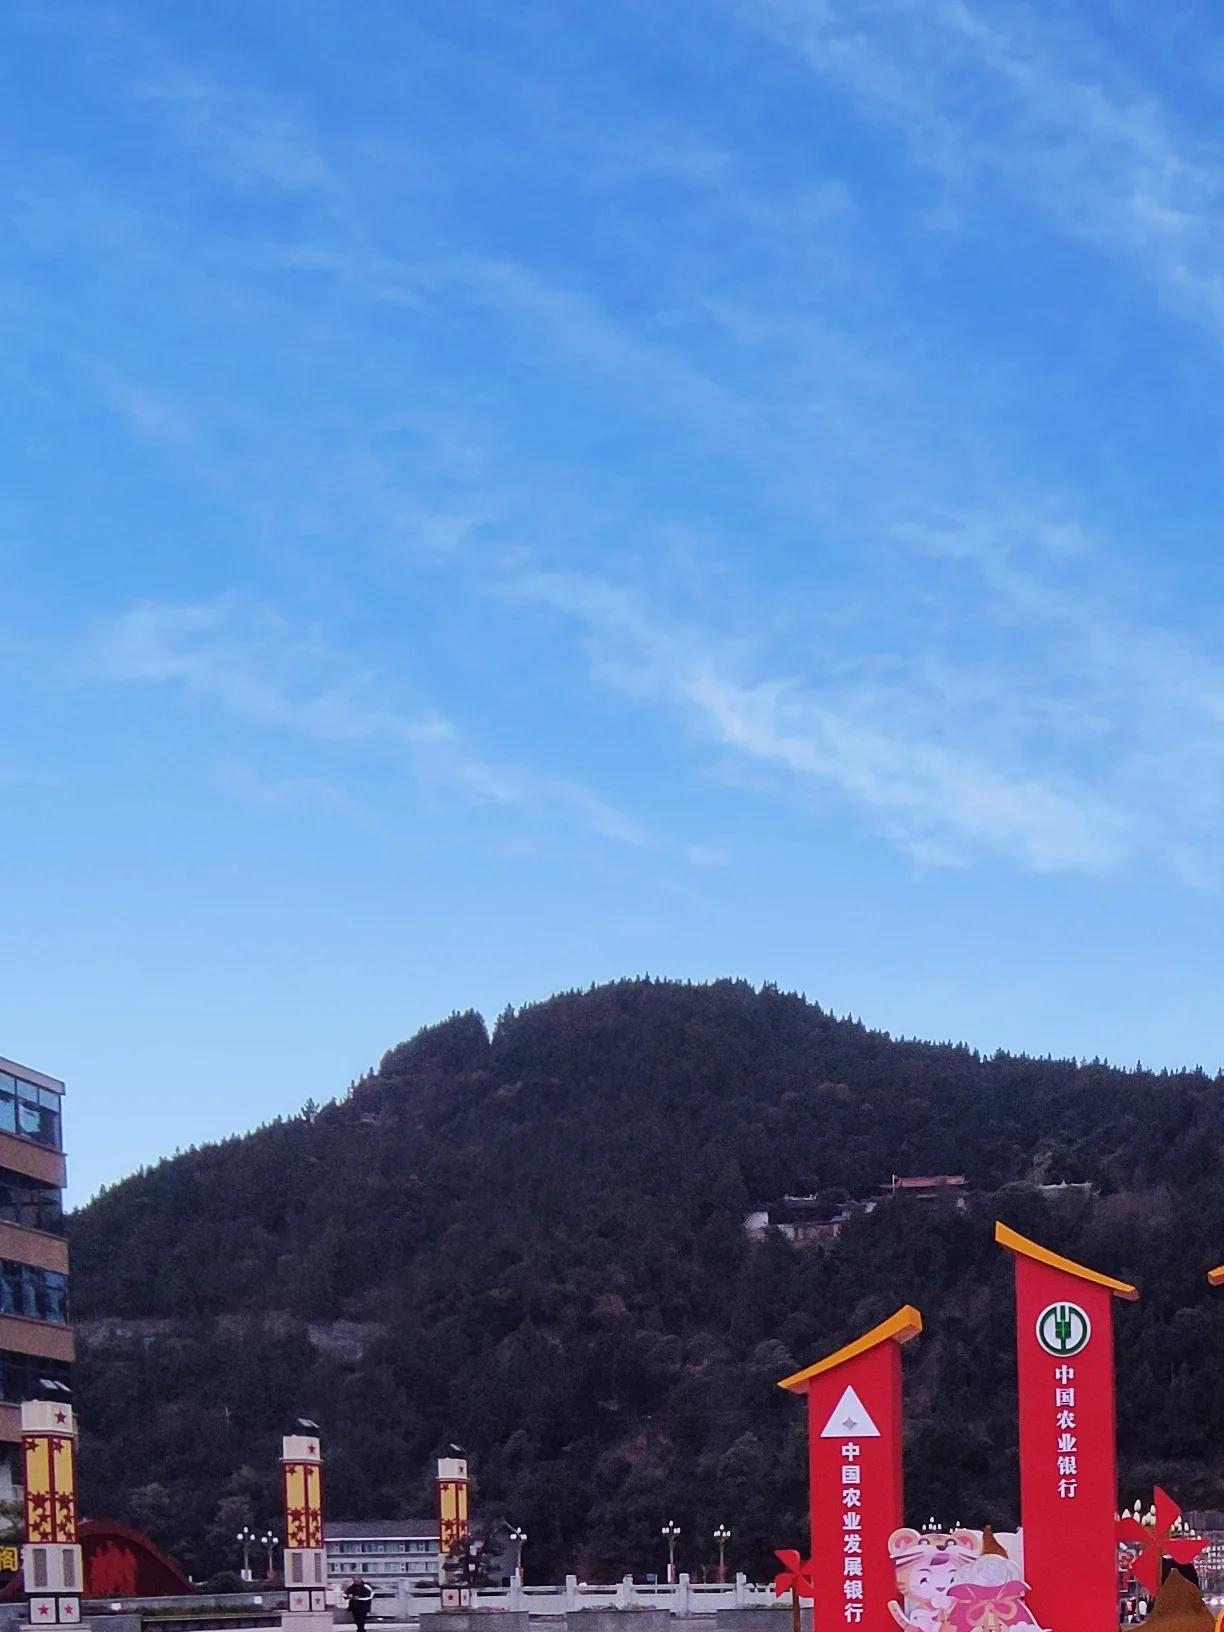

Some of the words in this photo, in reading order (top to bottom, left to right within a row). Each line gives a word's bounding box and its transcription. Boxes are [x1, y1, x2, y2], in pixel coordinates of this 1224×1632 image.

[1055, 1364, 1077, 1498] 中国农业银行
[841, 1441, 864, 1623] 中国农业发展银行
